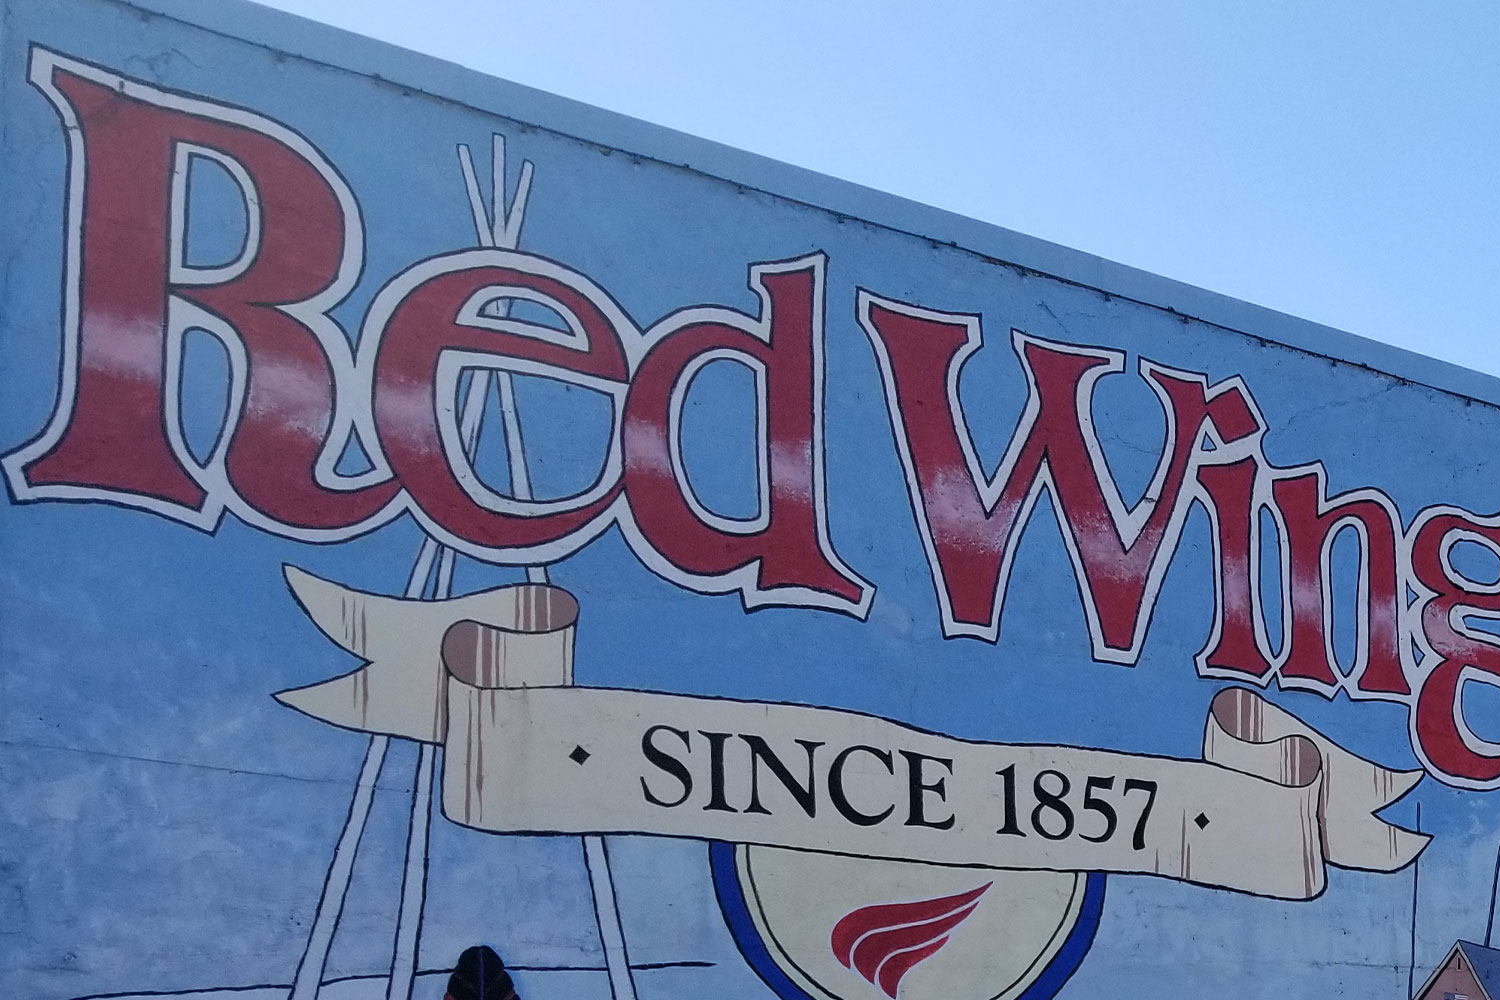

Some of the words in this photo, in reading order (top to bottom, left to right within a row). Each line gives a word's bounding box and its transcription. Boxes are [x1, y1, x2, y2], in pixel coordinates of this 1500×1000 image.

[0, 41, 877, 622] Red
[639, 724, 956, 830] SINCE
[995, 763, 1158, 851] 1857
